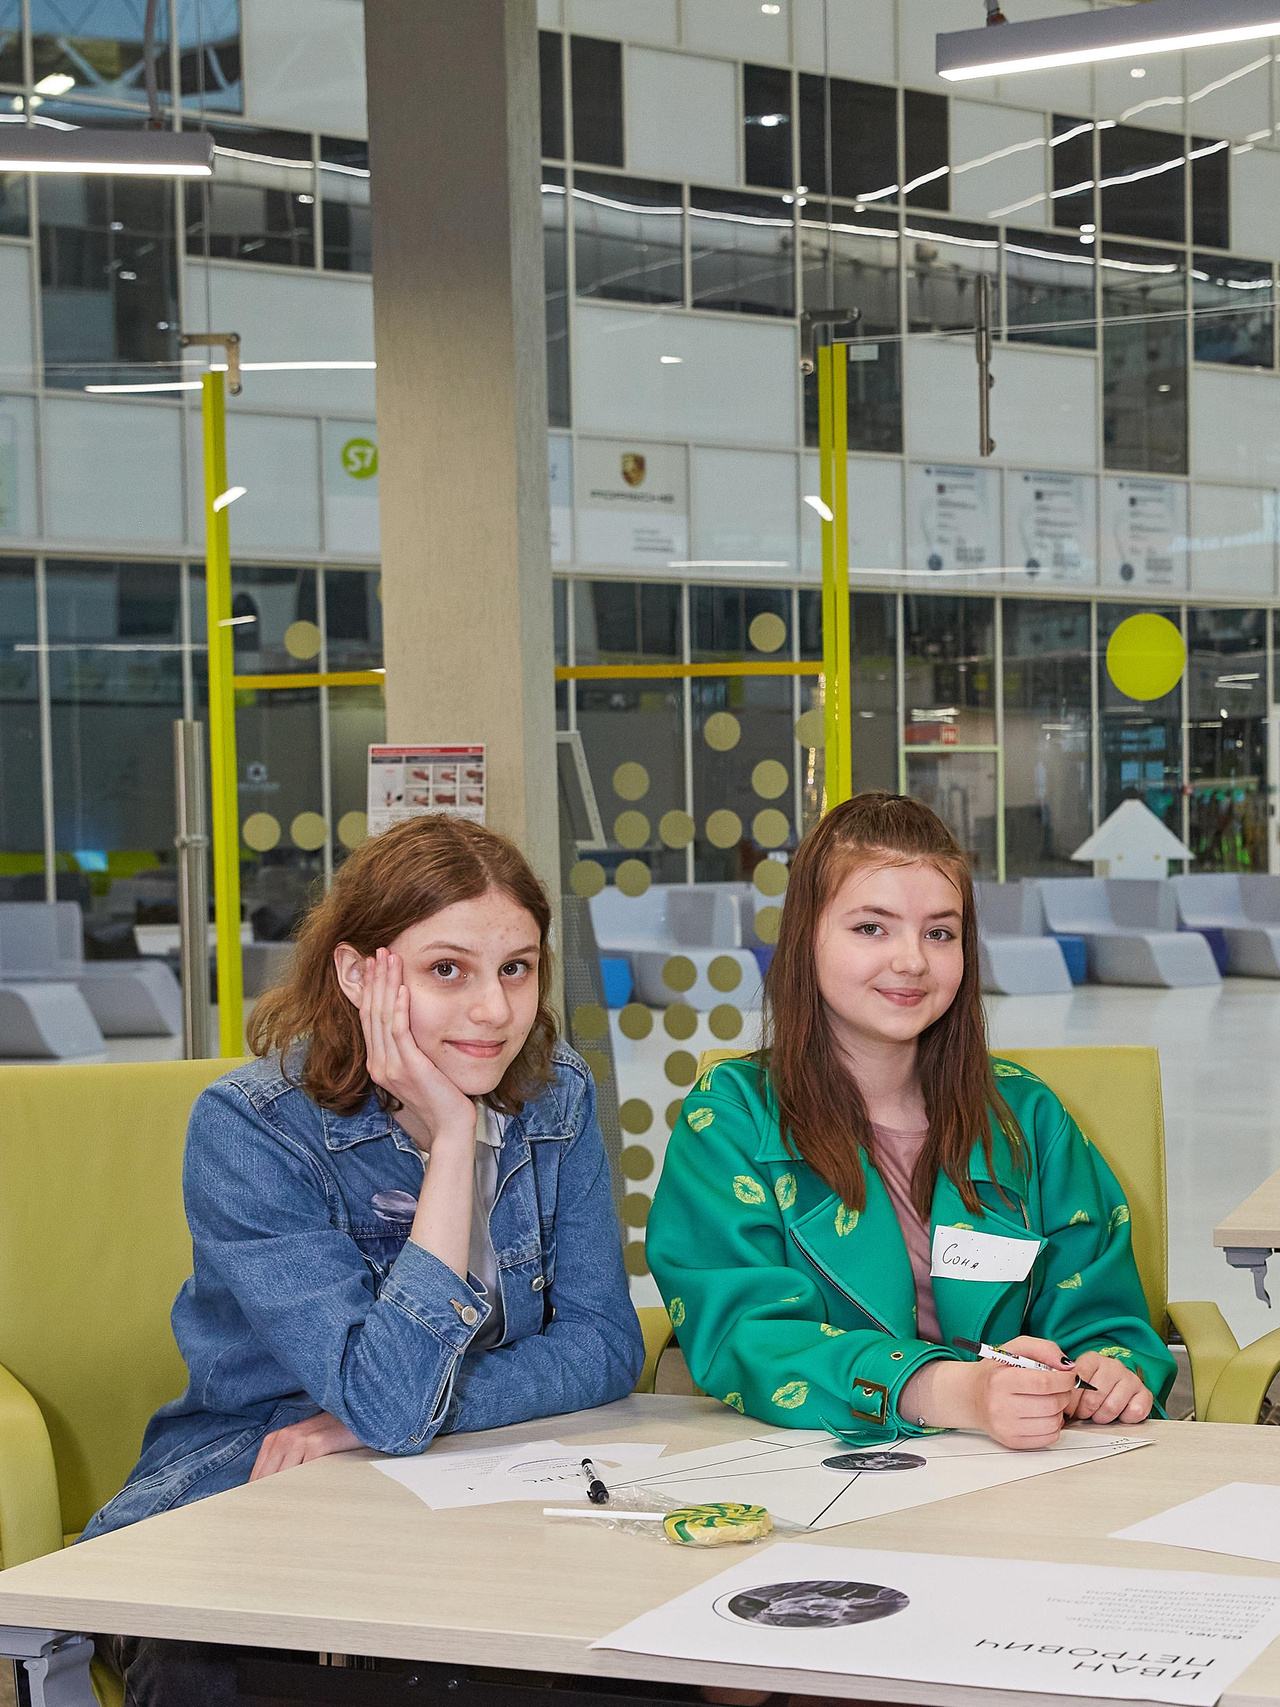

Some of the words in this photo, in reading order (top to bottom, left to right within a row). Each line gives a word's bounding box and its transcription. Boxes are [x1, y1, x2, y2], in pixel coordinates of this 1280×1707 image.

[348, 445, 374, 471] S7
[942, 1243, 980, 1270] Соня
[975, 1638, 1216, 1667] ПЕТРОВИЧ
[1072, 1661, 1202, 1680] ИВАН
